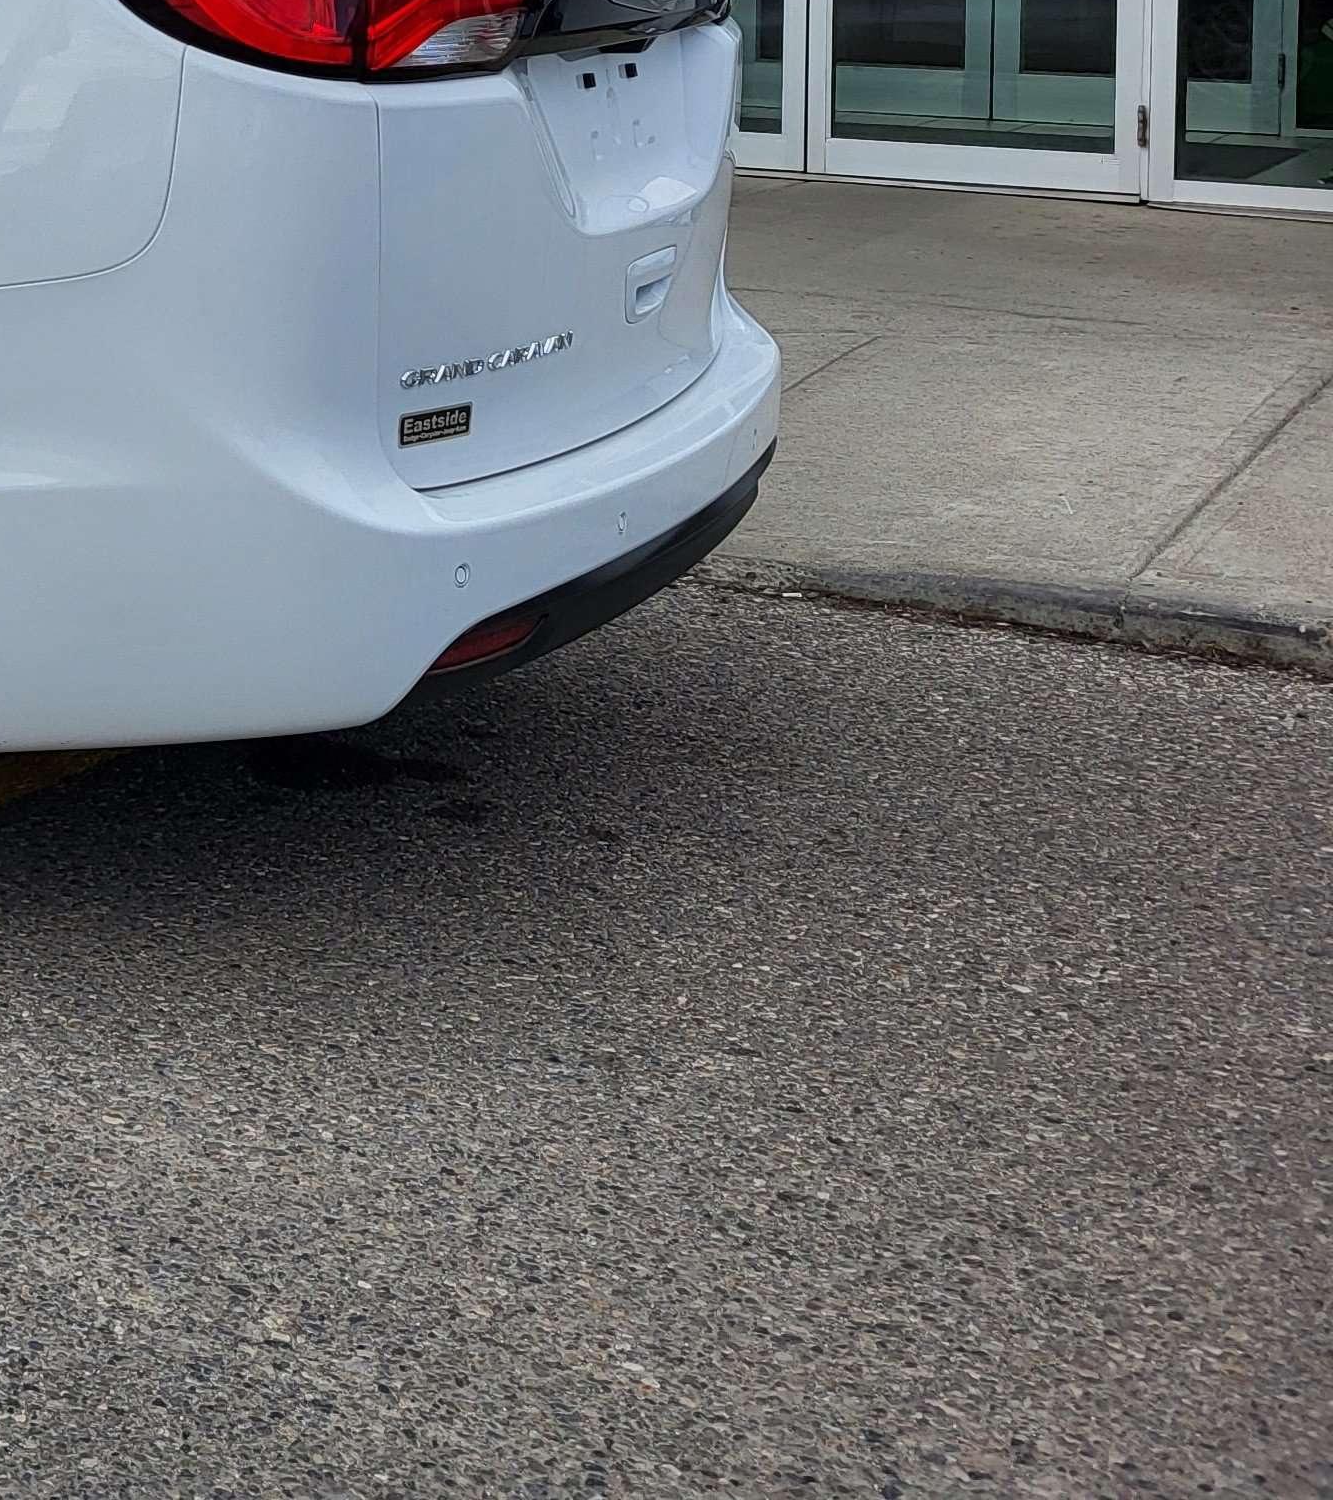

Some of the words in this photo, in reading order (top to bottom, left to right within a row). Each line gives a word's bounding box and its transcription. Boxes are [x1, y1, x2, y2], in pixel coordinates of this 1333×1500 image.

[400, 358, 484, 389] GRAND
[487, 330, 574, 371] CARAVAN
[404, 409, 467, 434] Eastside
